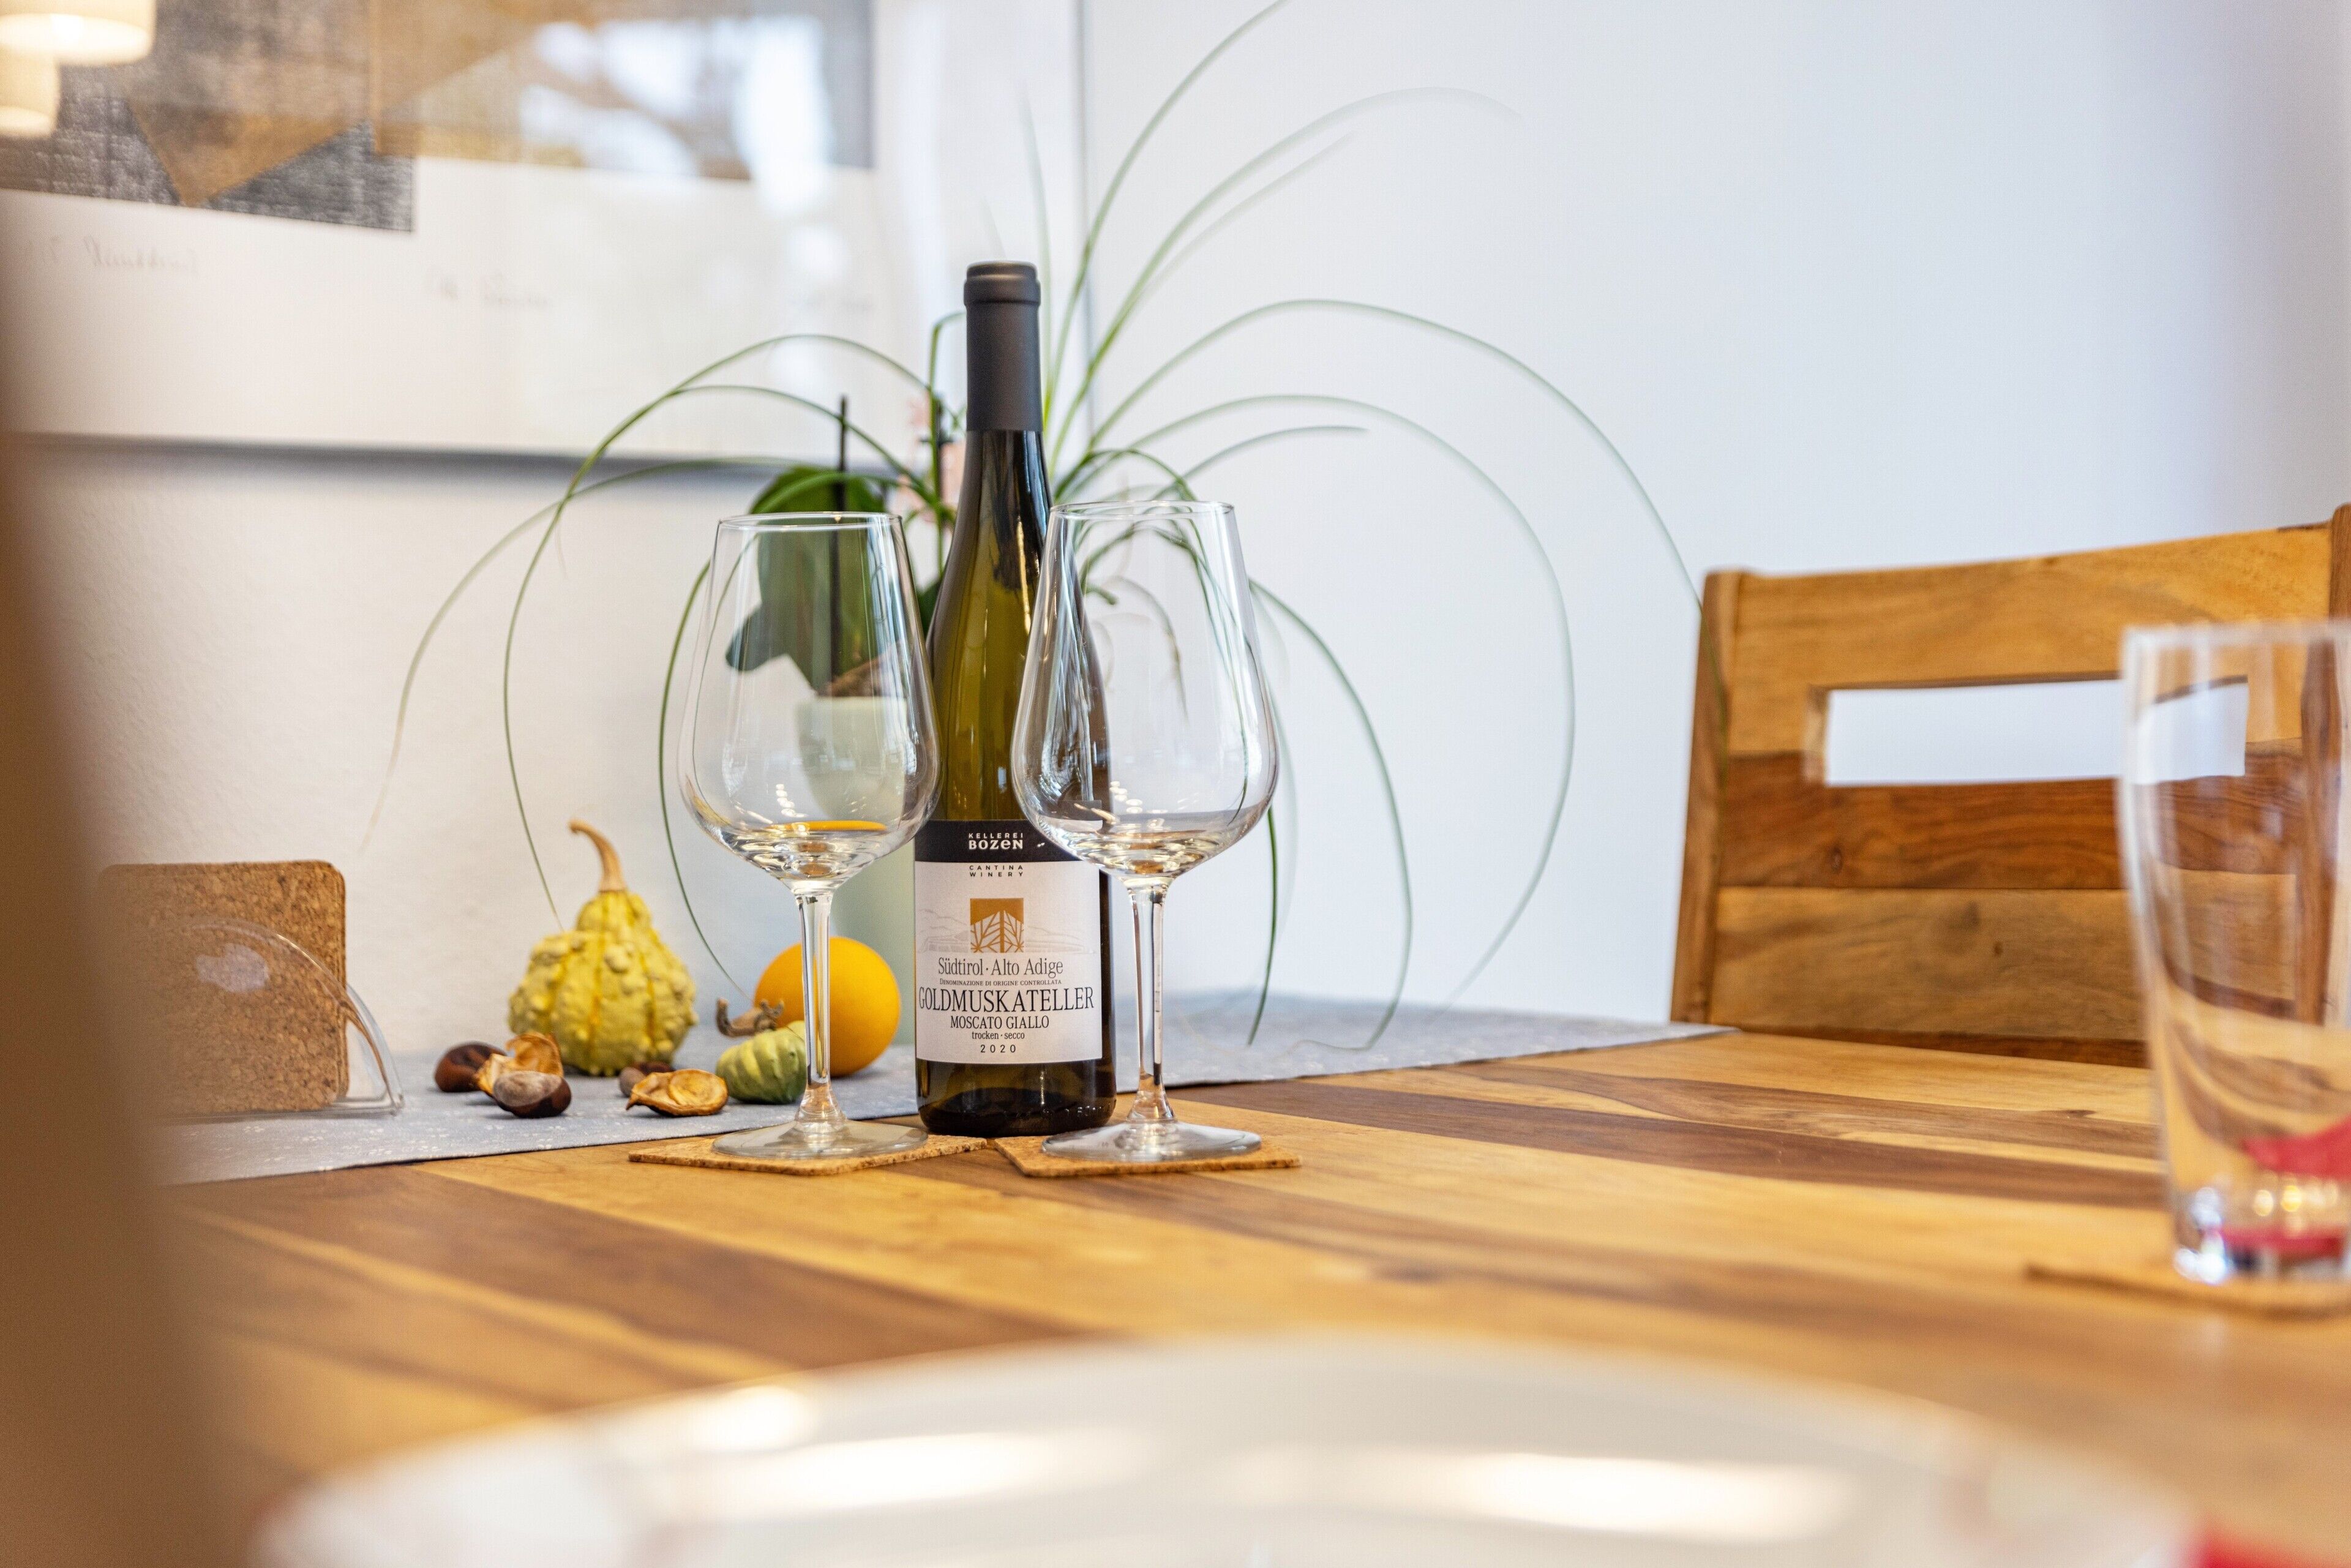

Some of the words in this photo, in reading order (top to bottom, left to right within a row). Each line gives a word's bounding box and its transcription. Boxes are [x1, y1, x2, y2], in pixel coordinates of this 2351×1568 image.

[991, 958, 1019, 975] Alto
[1024, 958, 1063, 978] Adige
[919, 986, 1094, 1013] GOLDMUSKATELLER
[950, 1016, 1002, 1029] MOSCATO
[1006, 1015, 1049, 1029] GIALLO
